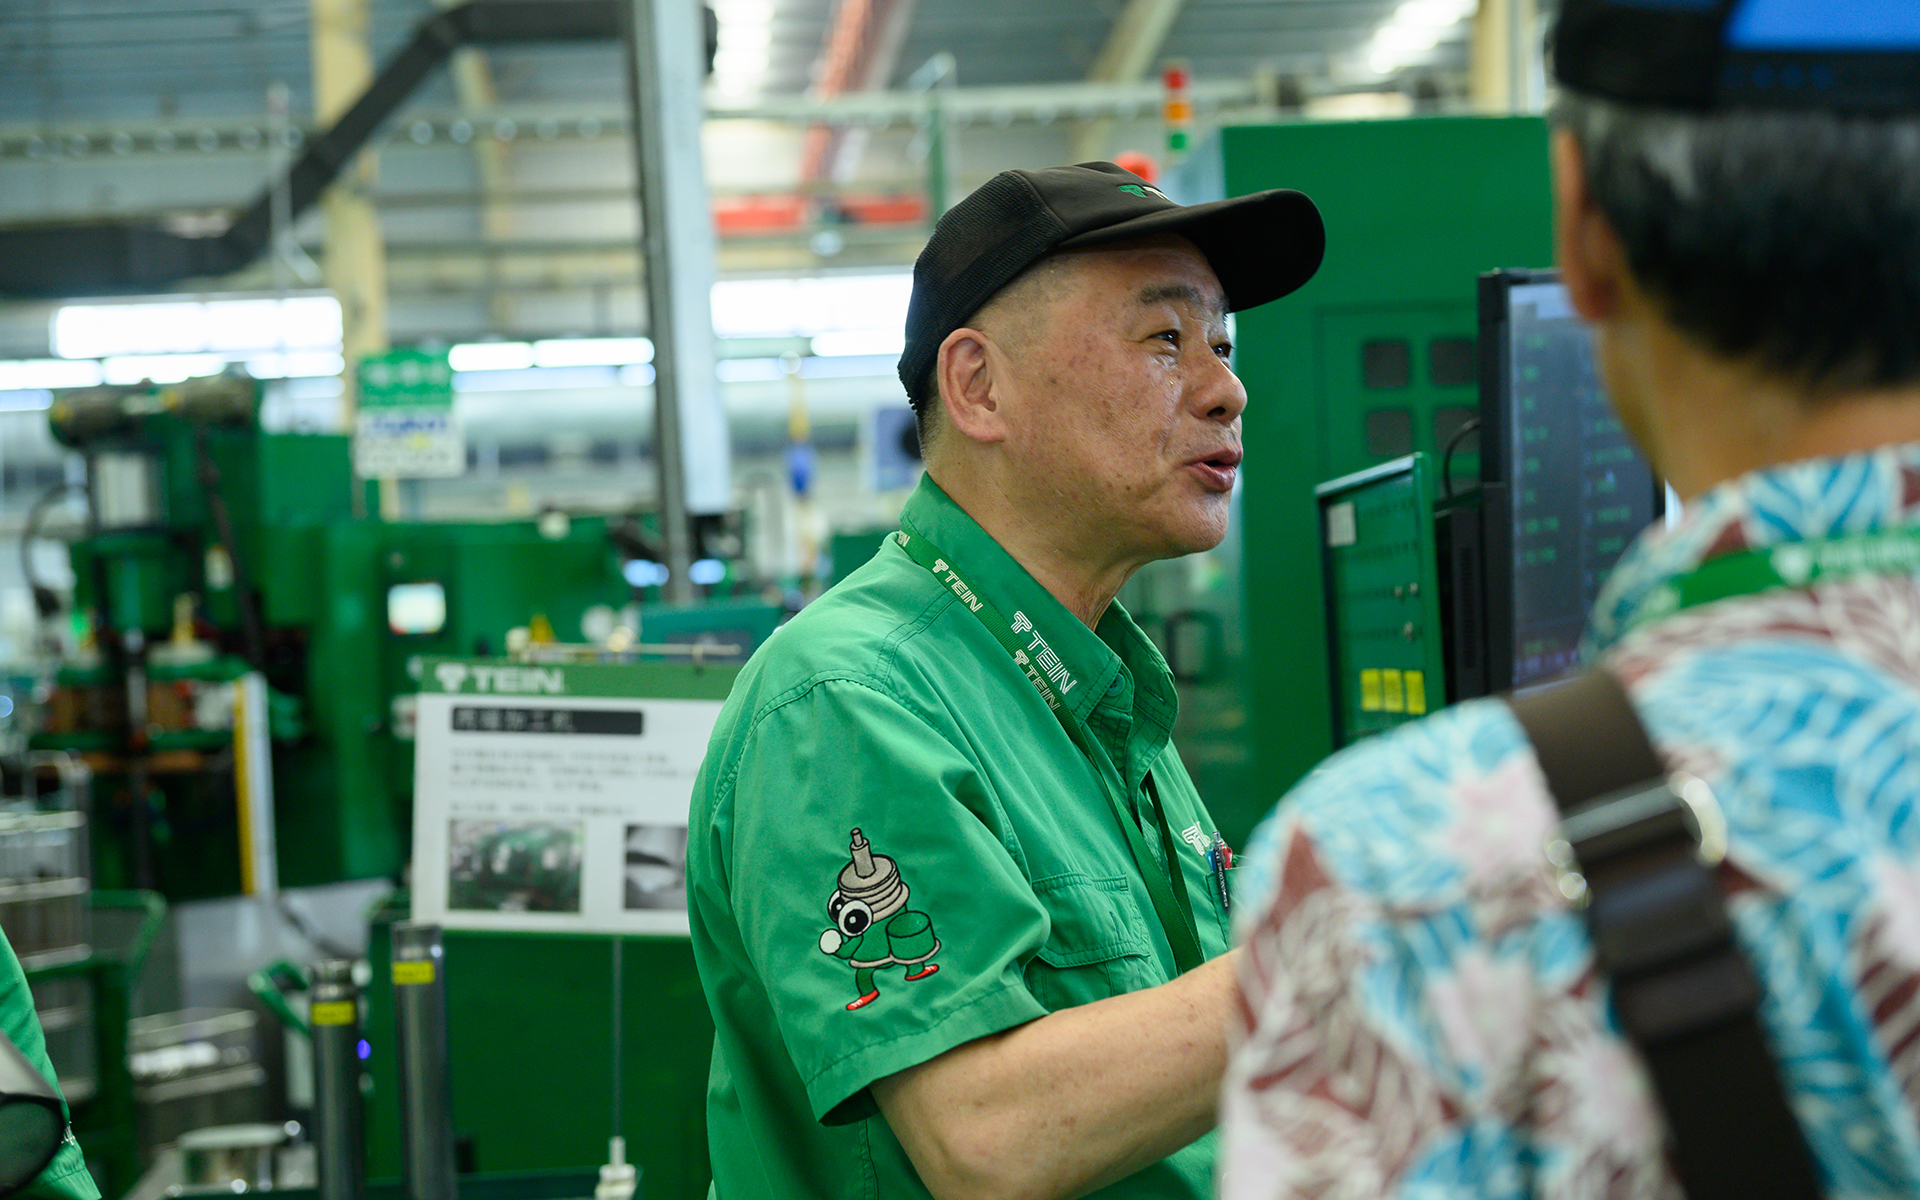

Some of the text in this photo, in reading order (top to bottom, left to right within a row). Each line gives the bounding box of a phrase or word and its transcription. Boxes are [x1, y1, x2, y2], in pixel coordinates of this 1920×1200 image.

[945, 570, 983, 612] TEIN
[472, 666, 564, 694] TEIN
[1027, 630, 1077, 695] TEIN
[1026, 664, 1061, 710] TEIN
